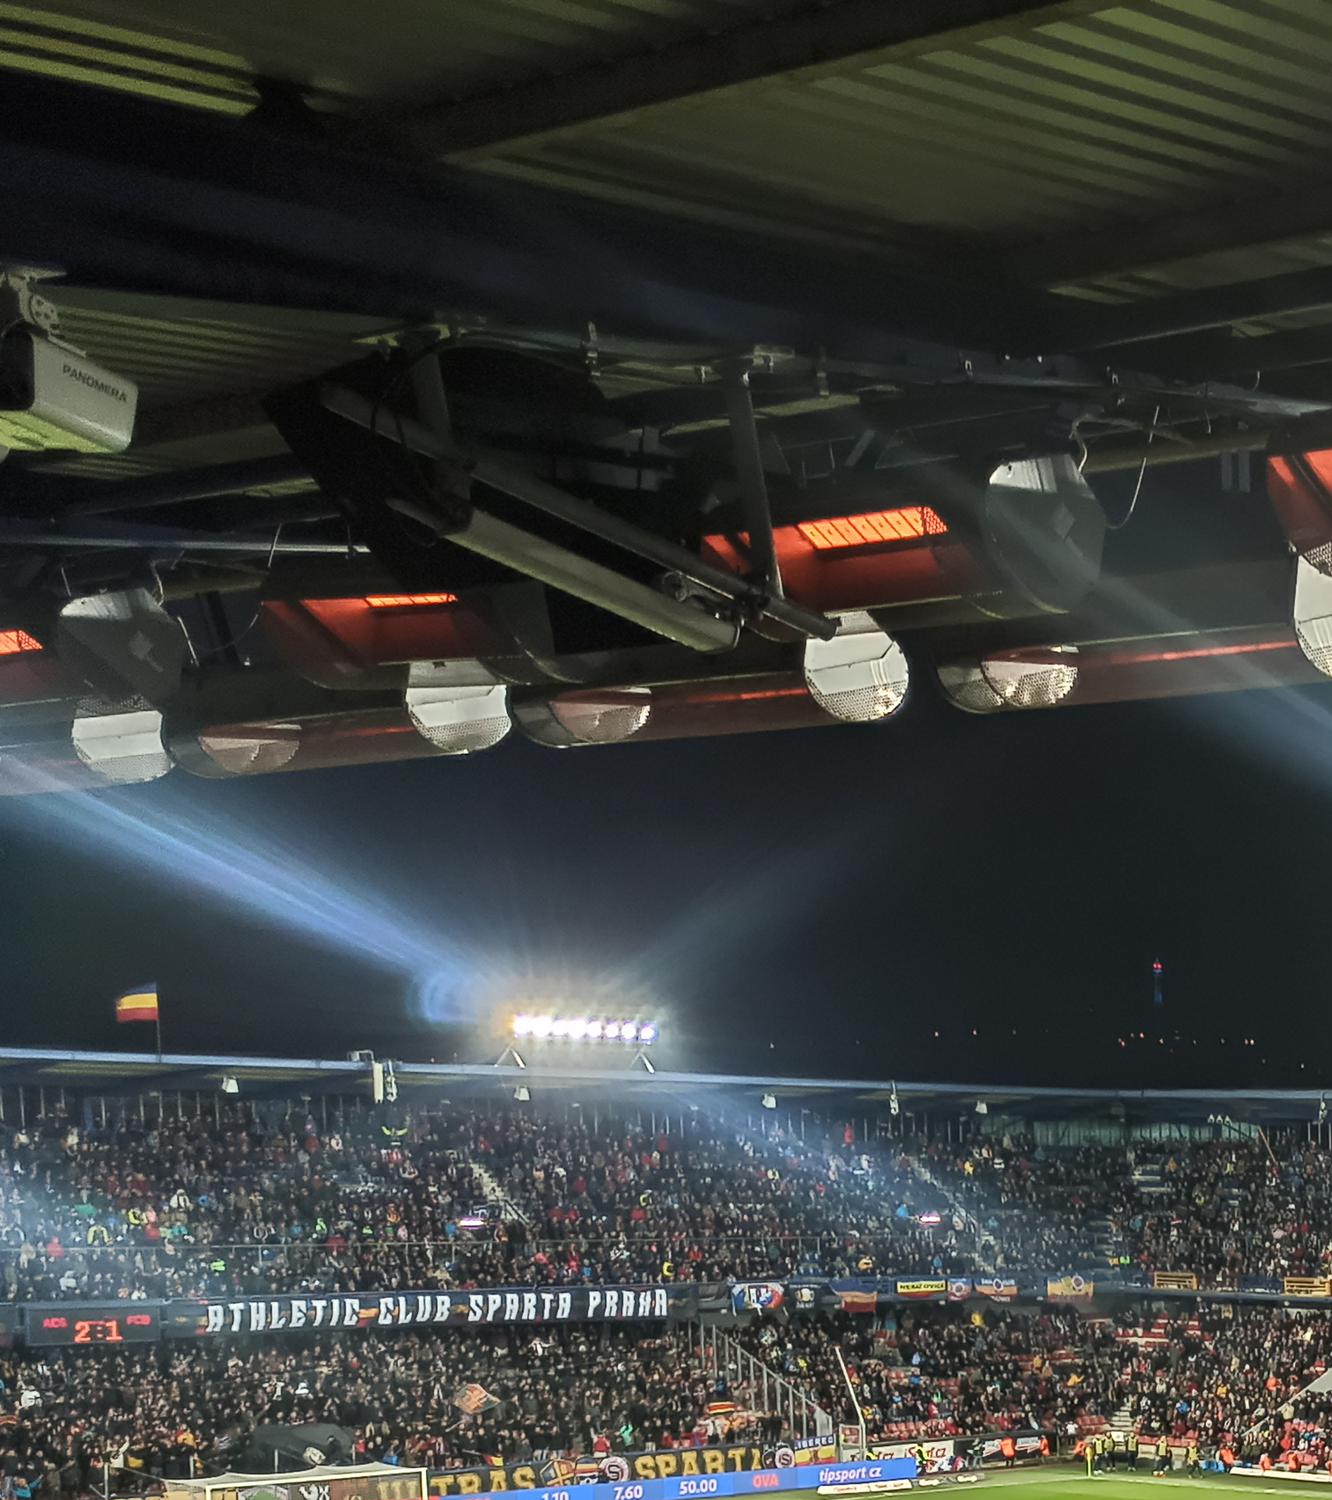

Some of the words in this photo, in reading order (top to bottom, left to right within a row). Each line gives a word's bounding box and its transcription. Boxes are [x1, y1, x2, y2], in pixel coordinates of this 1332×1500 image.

[63, 364, 127, 402] PANOMERA
[206, 1298, 360, 1332] ATHLETIC
[378, 1296, 451, 1325] CLUB
[467, 1293, 571, 1322] SPARTA
[587, 1289, 667, 1317] PRAHA
[634, 1447, 762, 1480] SPARTA
[679, 1478, 717, 1494] 50.00
[753, 1473, 780, 1487] OVA
[614, 1485, 643, 1500] 7.60
